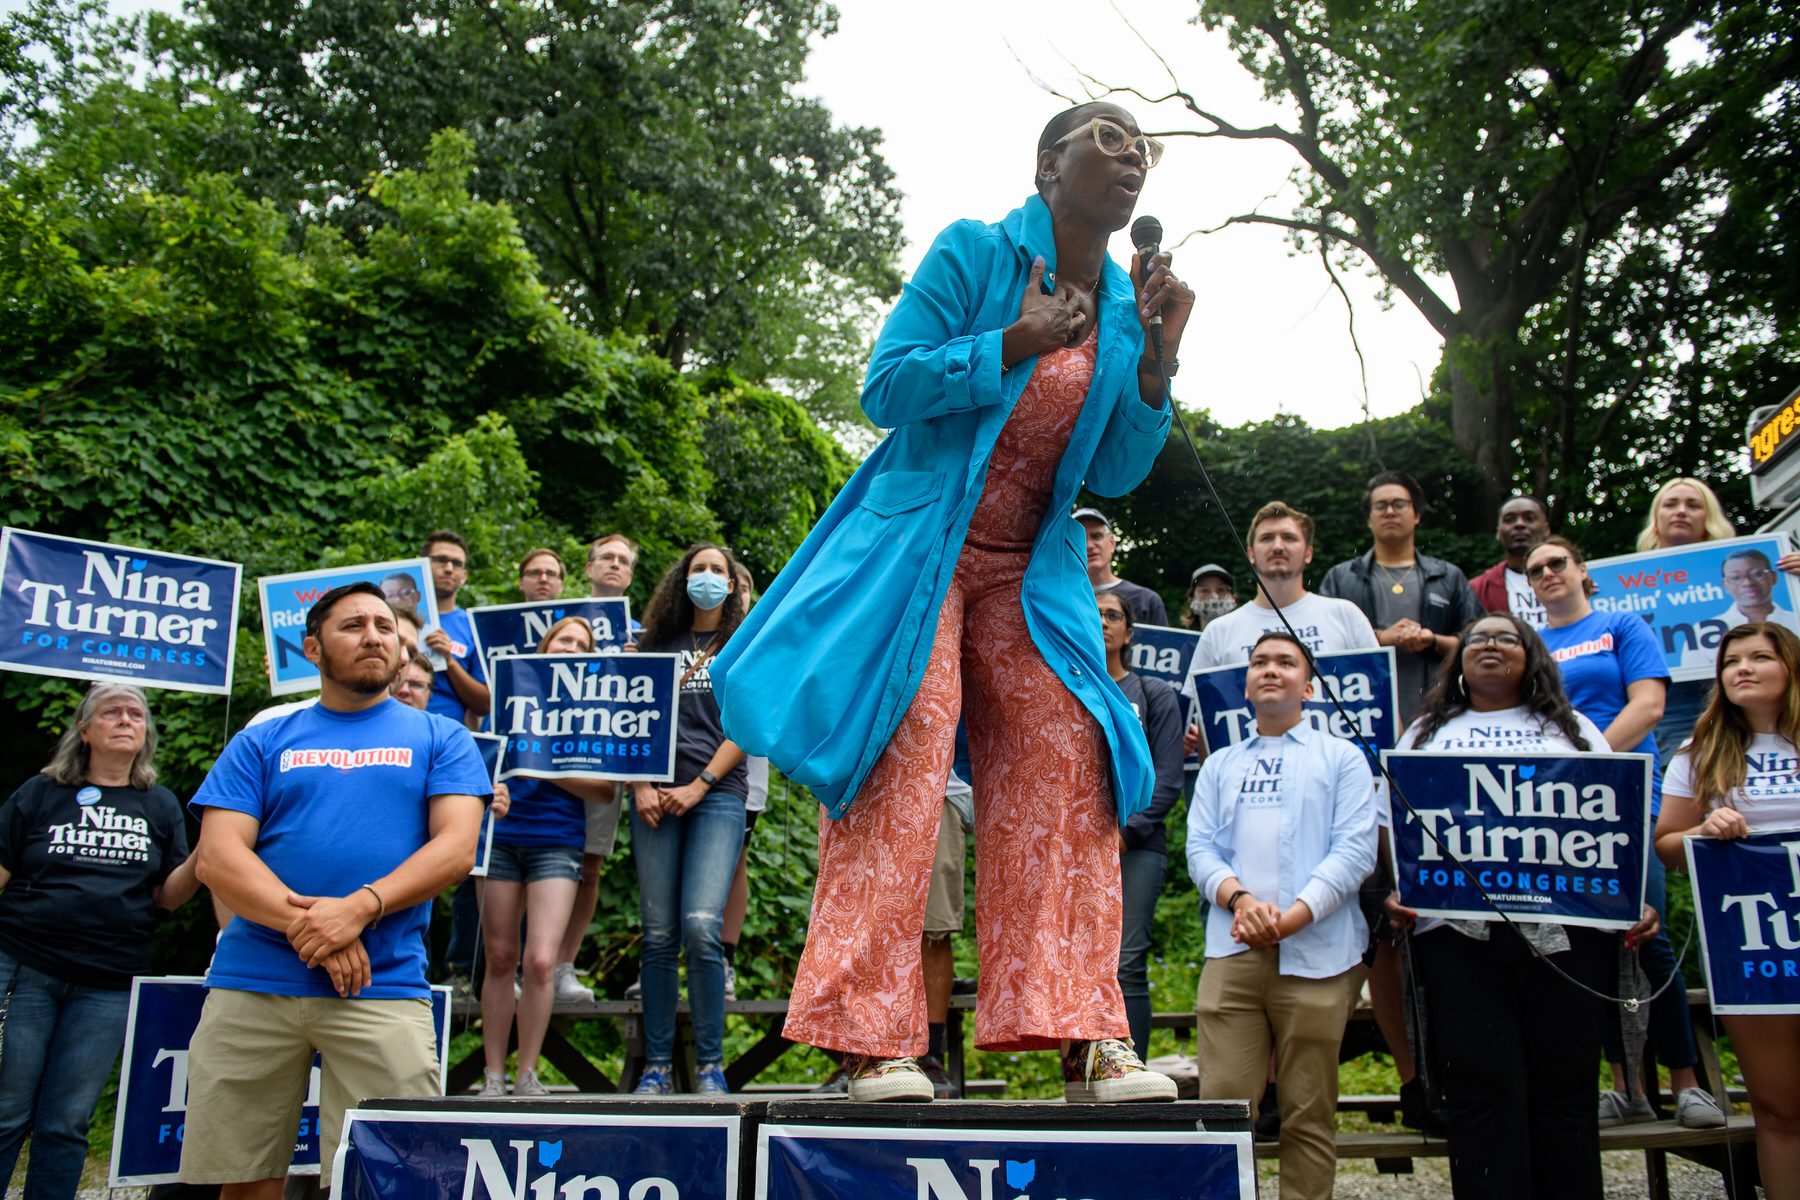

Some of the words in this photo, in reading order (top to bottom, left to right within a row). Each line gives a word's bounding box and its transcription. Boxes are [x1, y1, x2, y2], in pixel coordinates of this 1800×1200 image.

[77, 550, 212, 611] Nina
[1618, 569, 1688, 590] We're
[1666, 582, 1724, 606] with
[18, 579, 218, 646] Turner
[21, 631, 70, 650] FOR
[82, 640, 206, 667] CONGRESS
[82, 656, 146, 670] NINATURNER.COM
[546, 662, 656, 703] Nina
[504, 696, 661, 738] Turner
[1214, 706, 1383, 743] Tner
[1442, 737, 1547, 750] Turner
[1469, 726, 1544, 738] Nina
[292, 749, 410, 767] REVOLUTION
[507, 739, 542, 754] FOR
[551, 741, 652, 757] CONGRESS
[1463, 763, 1621, 822] Nina
[78, 806, 148, 835] Nina
[48, 822, 152, 851] Turner
[1406, 808, 1629, 869] Turner
[48, 845, 75, 854] FOR
[80, 848, 149, 861] CONGRESS
[1419, 869, 1466, 887] FOR
[1479, 871, 1621, 896] CONGRESS
